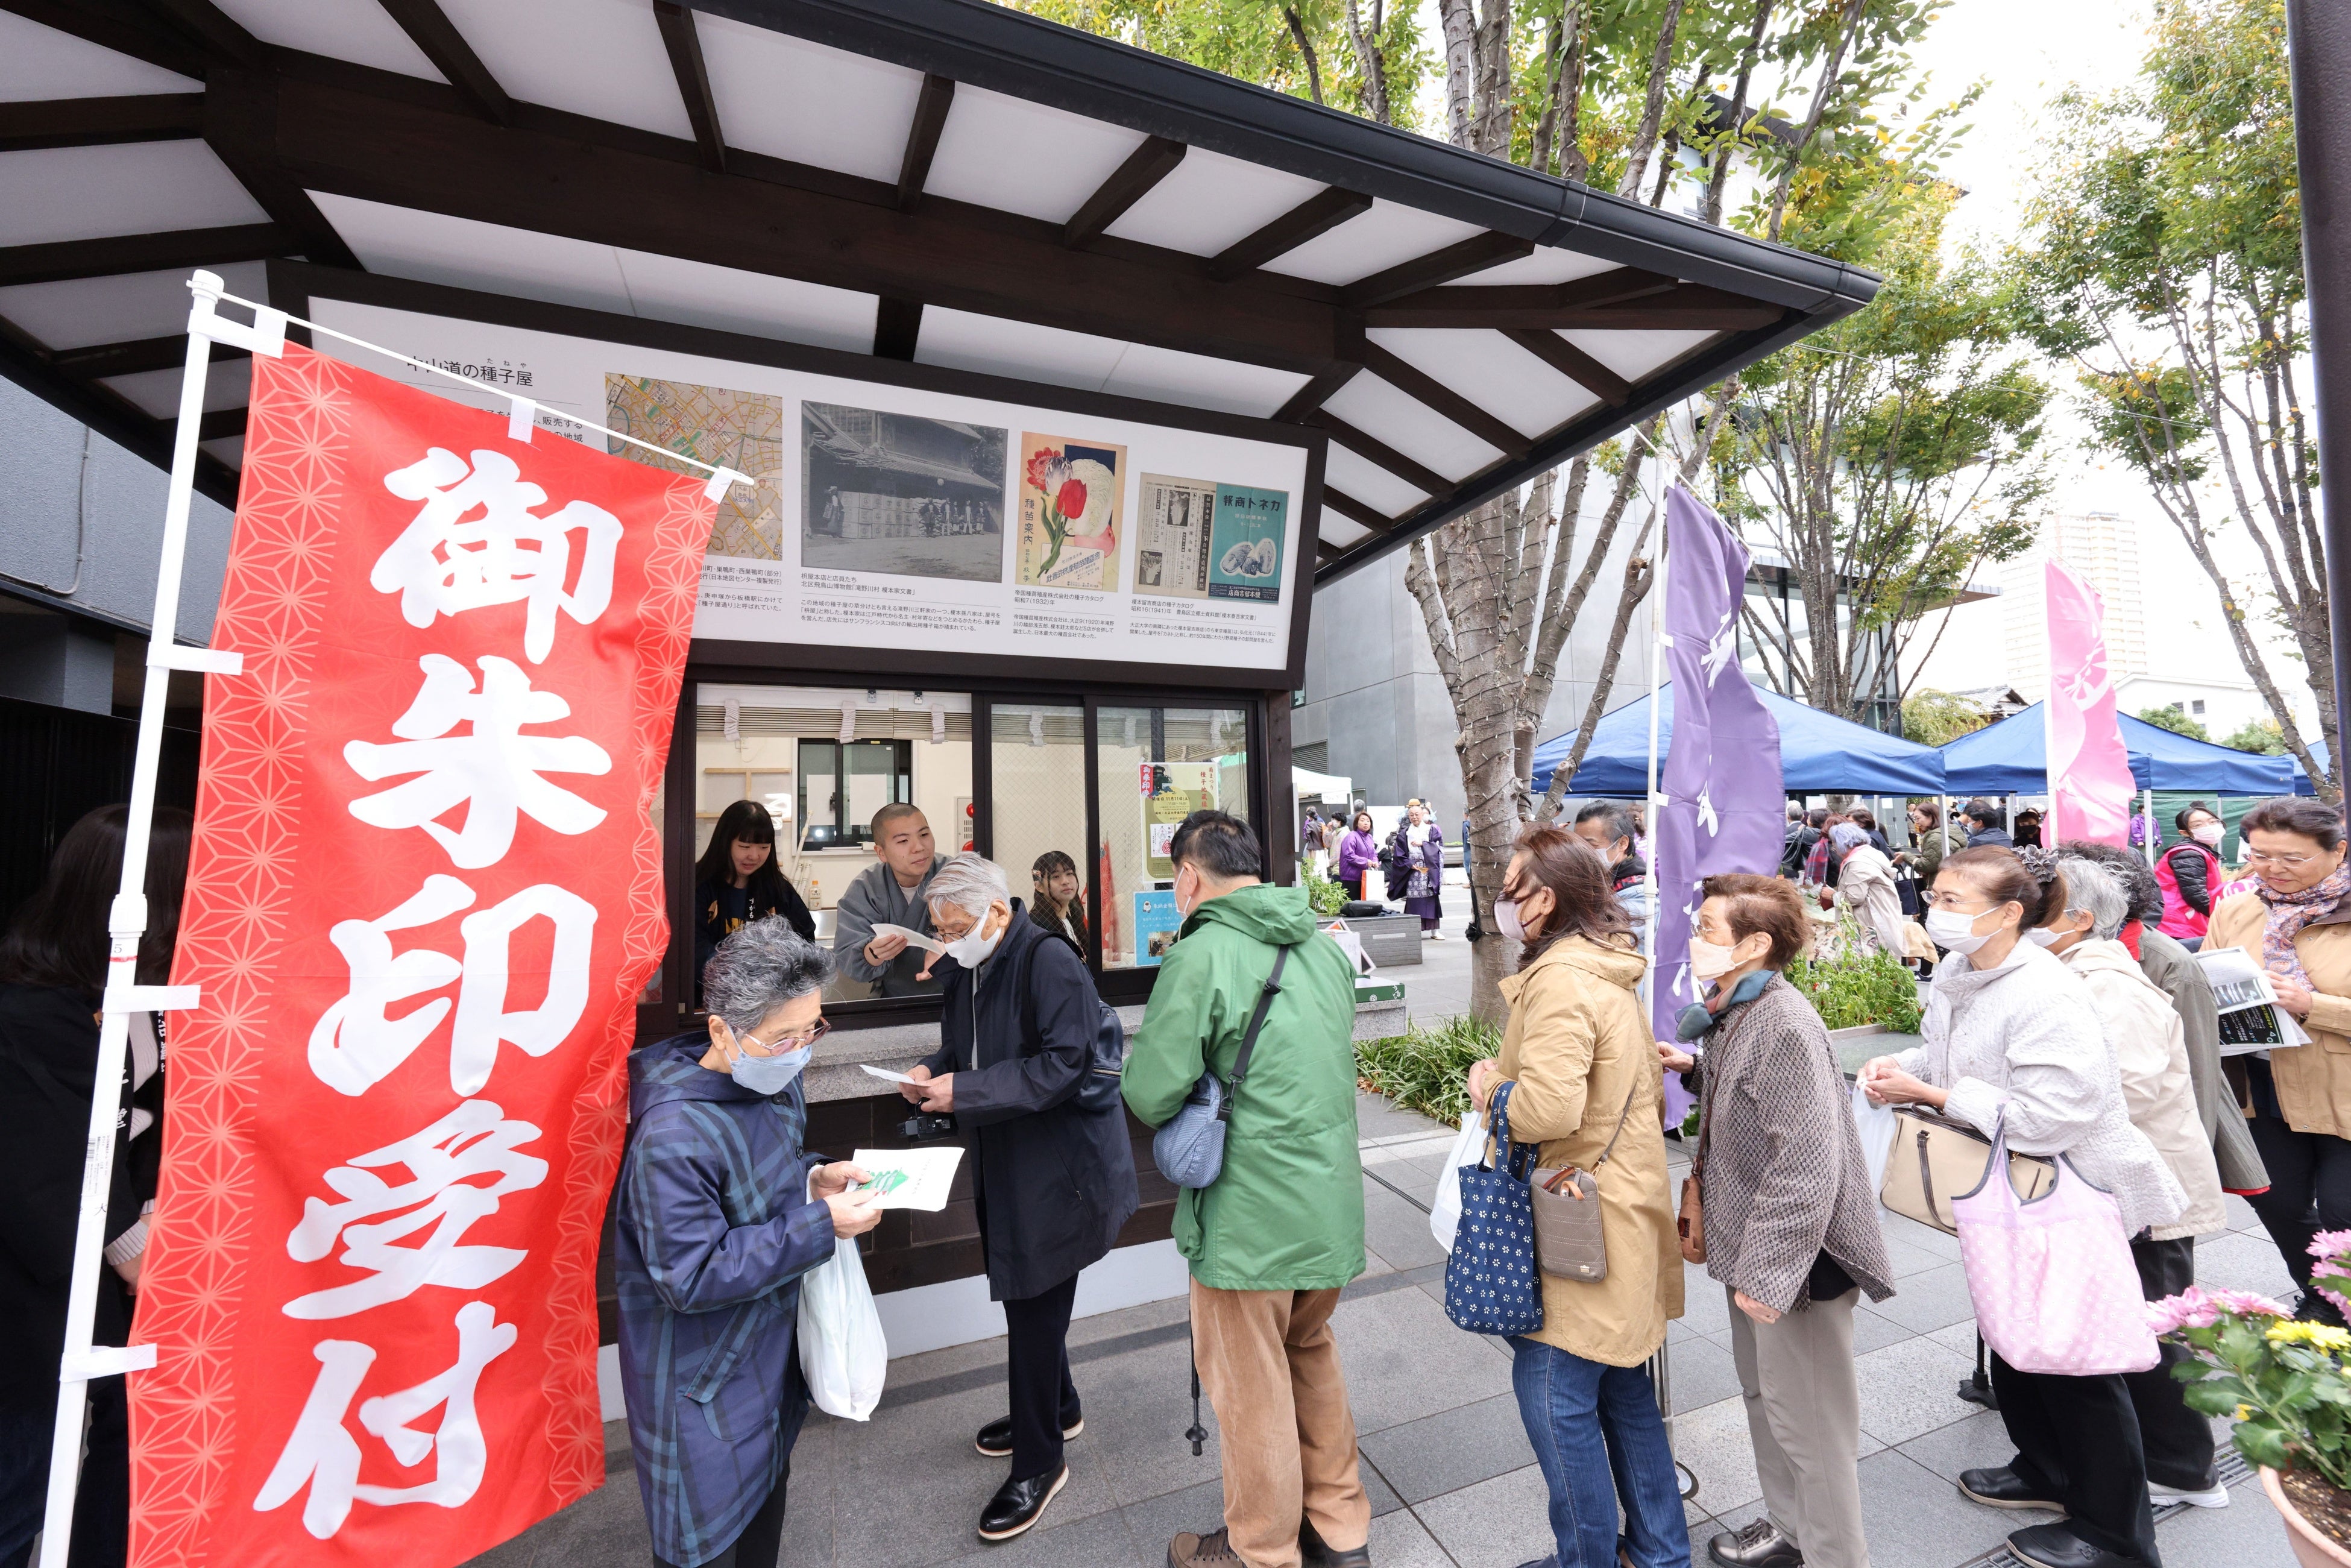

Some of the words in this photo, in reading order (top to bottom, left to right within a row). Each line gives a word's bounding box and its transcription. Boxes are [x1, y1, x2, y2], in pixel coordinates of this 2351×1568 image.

[1024, 499, 1035, 546] 種苗案内
[700, 565, 782, 578] 川町・巣鴨町・西巣鴨町（部分）
[114, 944, 122, 954] 5
[253, 447, 624, 1540] 御朱印受付
